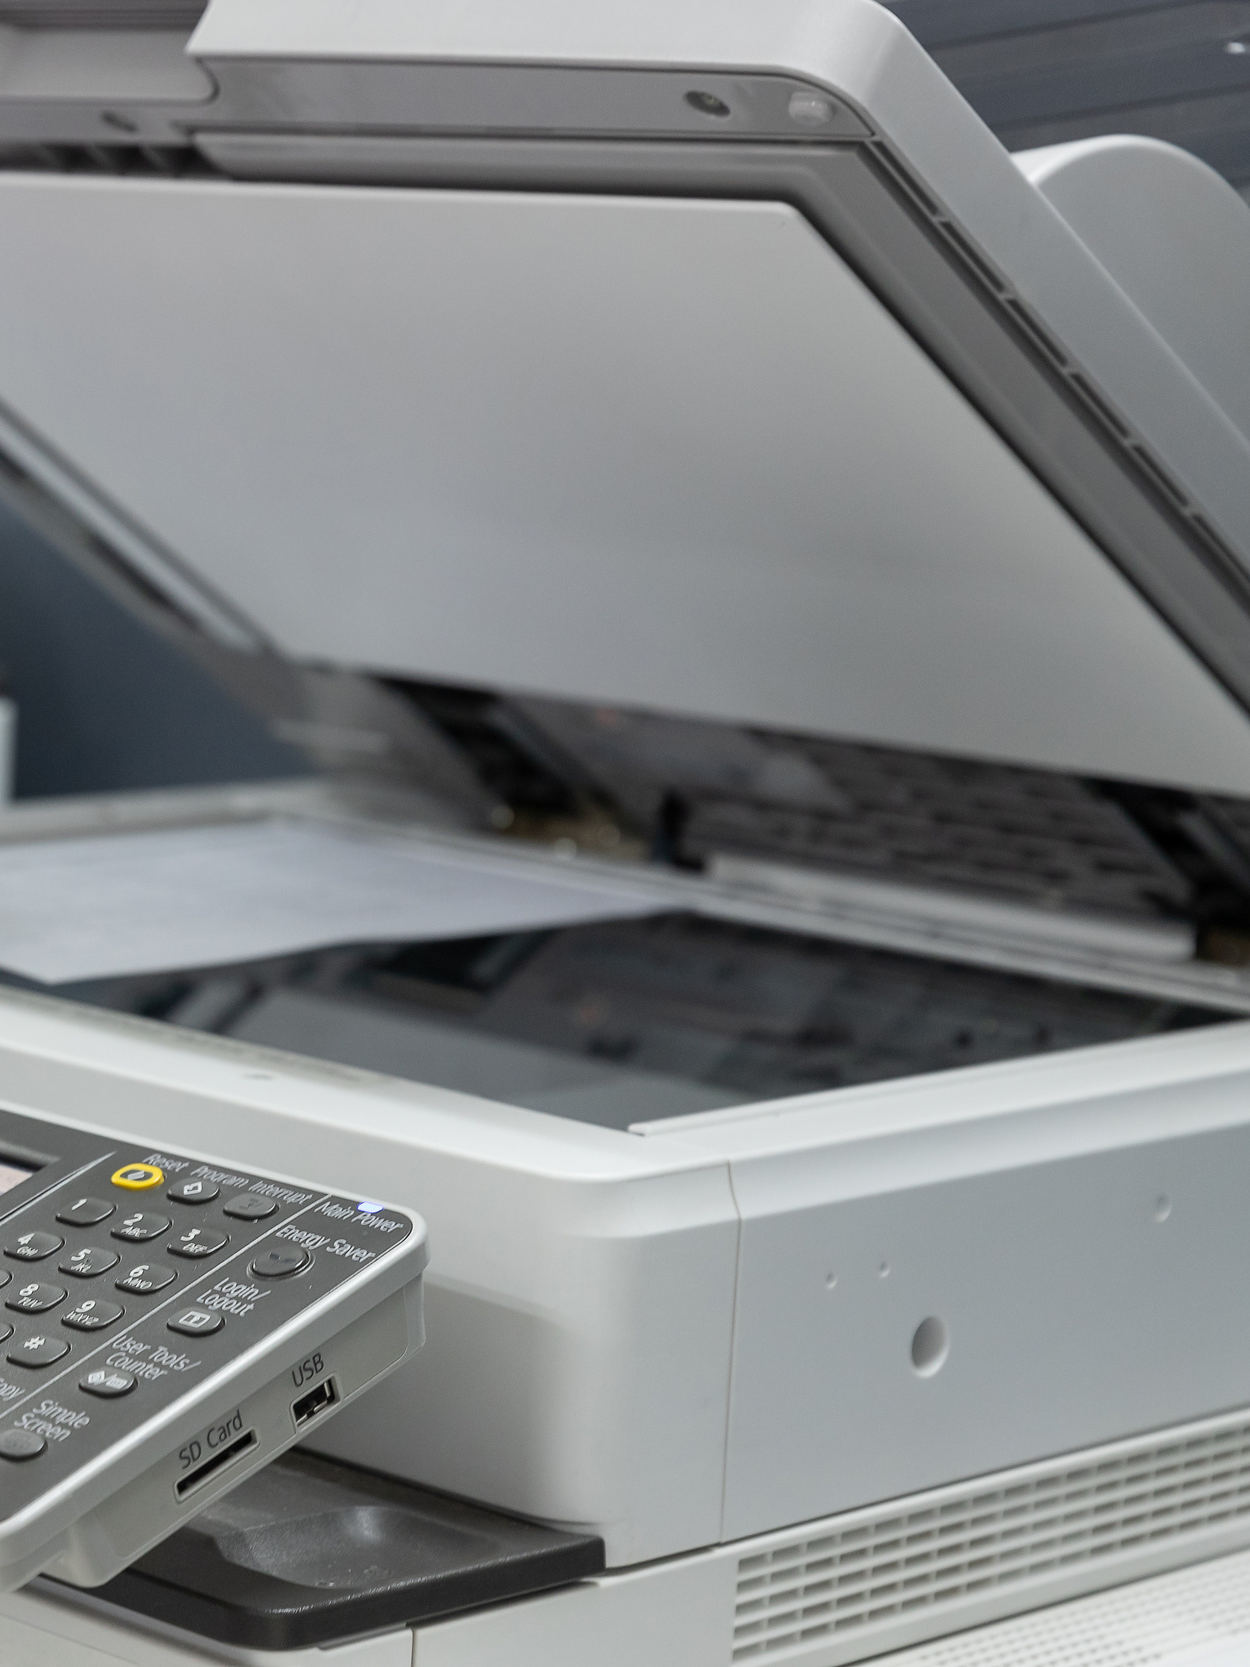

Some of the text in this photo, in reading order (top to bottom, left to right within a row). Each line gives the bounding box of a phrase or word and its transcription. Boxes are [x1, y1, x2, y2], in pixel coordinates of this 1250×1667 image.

[143, 1153, 189, 1173] Reset
[191, 1165, 250, 1189] Program
[249, 1180, 313, 1206] Interrupt
[71, 1198, 88, 1211] 1
[123, 1212, 145, 1226] 2
[314, 1200, 405, 1234] Main Power
[17, 1232, 35, 1246] 4
[120, 1226, 148, 1238] ABC
[180, 1228, 202, 1242] 3
[275, 1223, 377, 1264] Energy Saver
[70, 1248, 92, 1262] 5
[128, 1264, 150, 1278] 6
[18, 1283, 40, 1297] 8
[213, 1277, 271, 1301] Login/
[17, 1296, 44, 1308] TUV
[75, 1300, 97, 1314] 9
[196, 1290, 255, 1317] Logout
[23, 1335, 47, 1351] #
[112, 1335, 202, 1372] User Tools/
[105, 1352, 168, 1381] Counter
[291, 1353, 324, 1388] USB
[32, 1400, 91, 1429] Simple
[14, 1411, 72, 1442] Screen
[179, 1409, 243, 1469] SD Card
